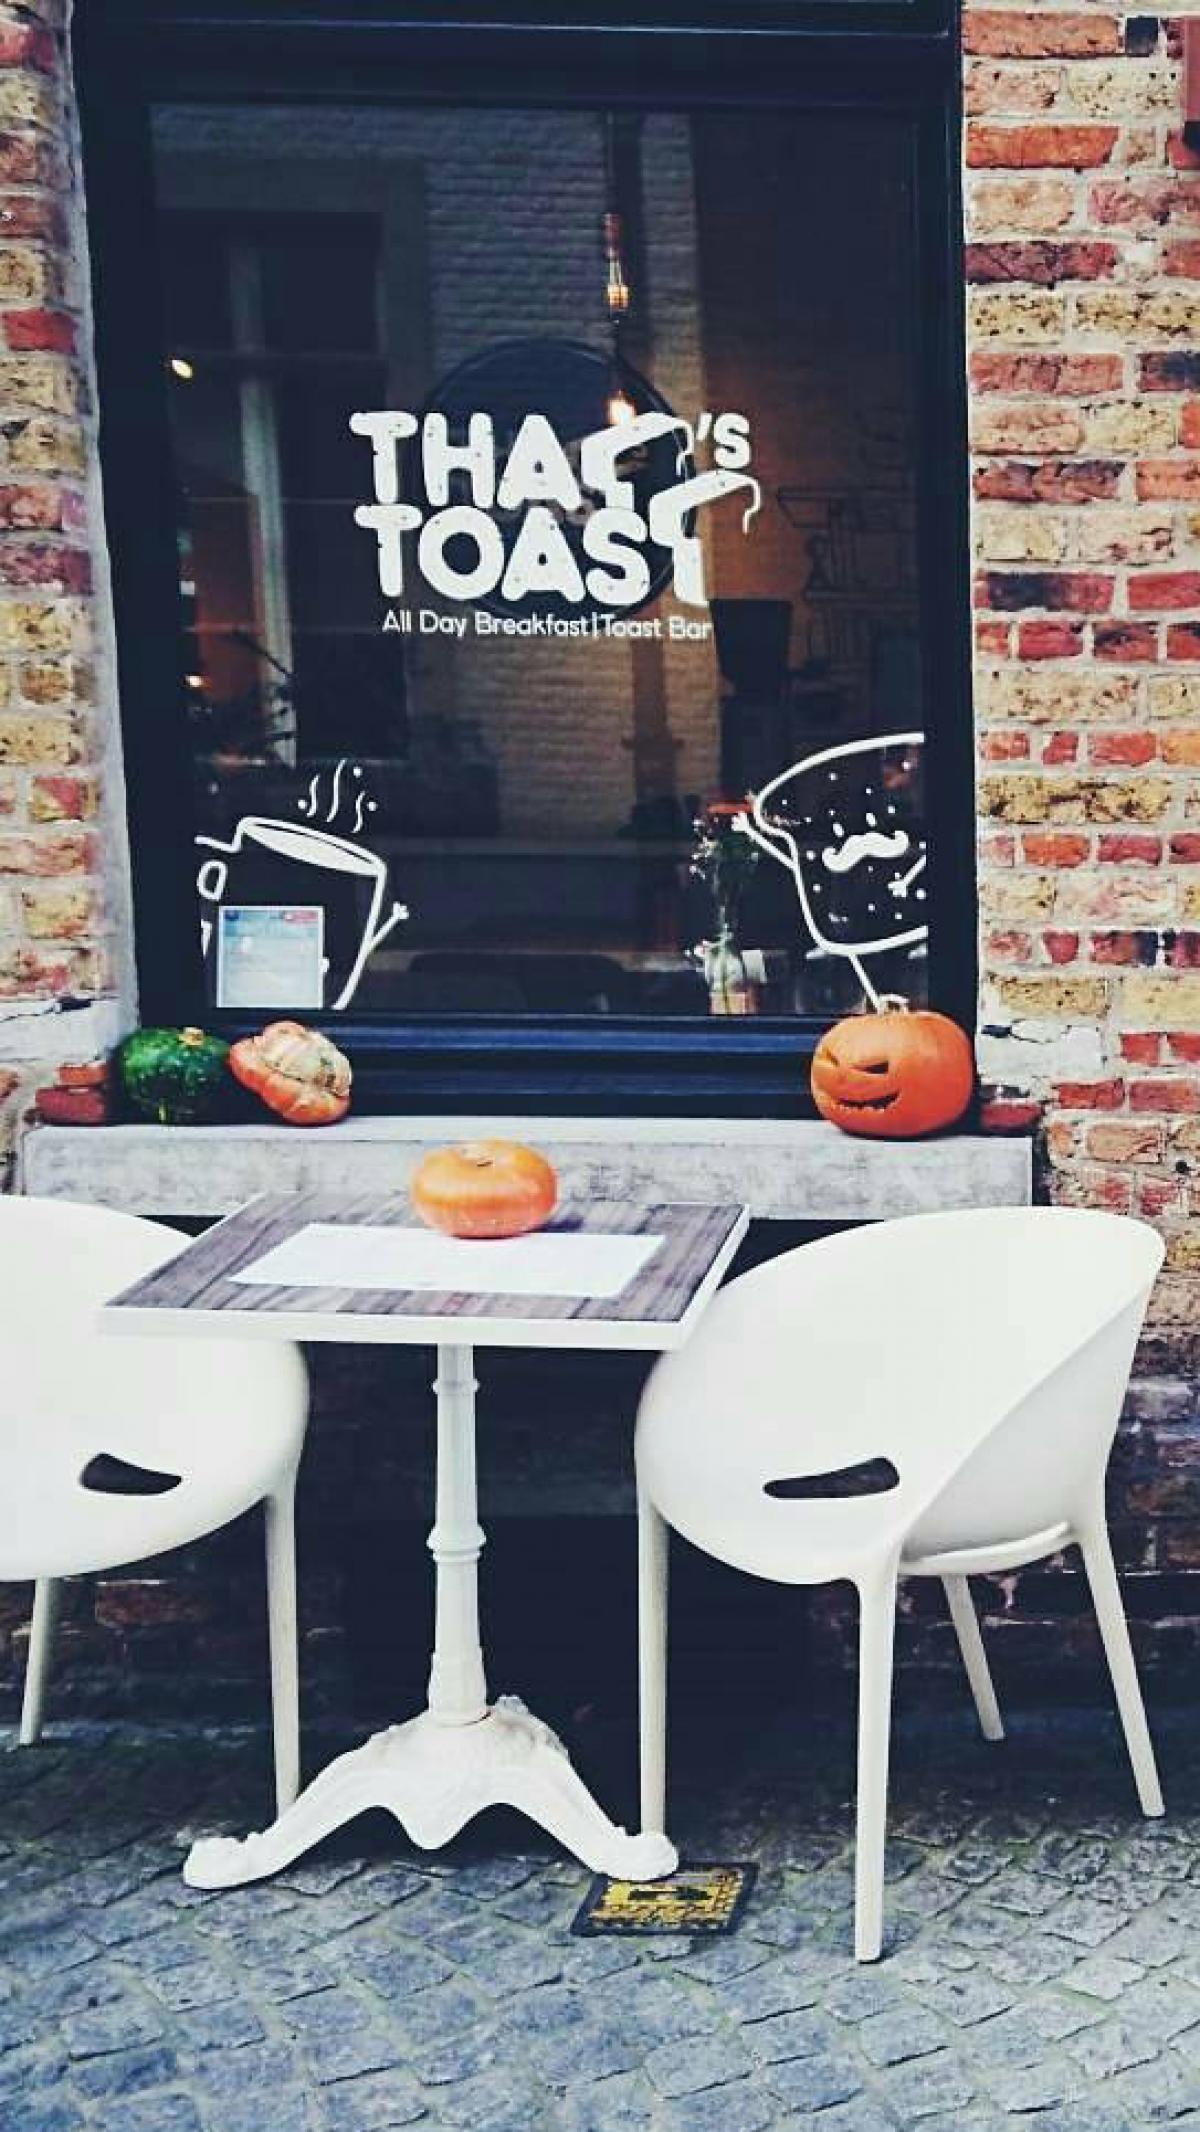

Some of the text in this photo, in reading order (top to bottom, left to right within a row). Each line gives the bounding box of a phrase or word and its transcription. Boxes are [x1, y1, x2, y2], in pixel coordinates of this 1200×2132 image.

[354, 469, 761, 606] TOAST
[382, 610, 412, 634] All
[419, 610, 467, 637] Day
[668, 616, 713, 640] Bar
